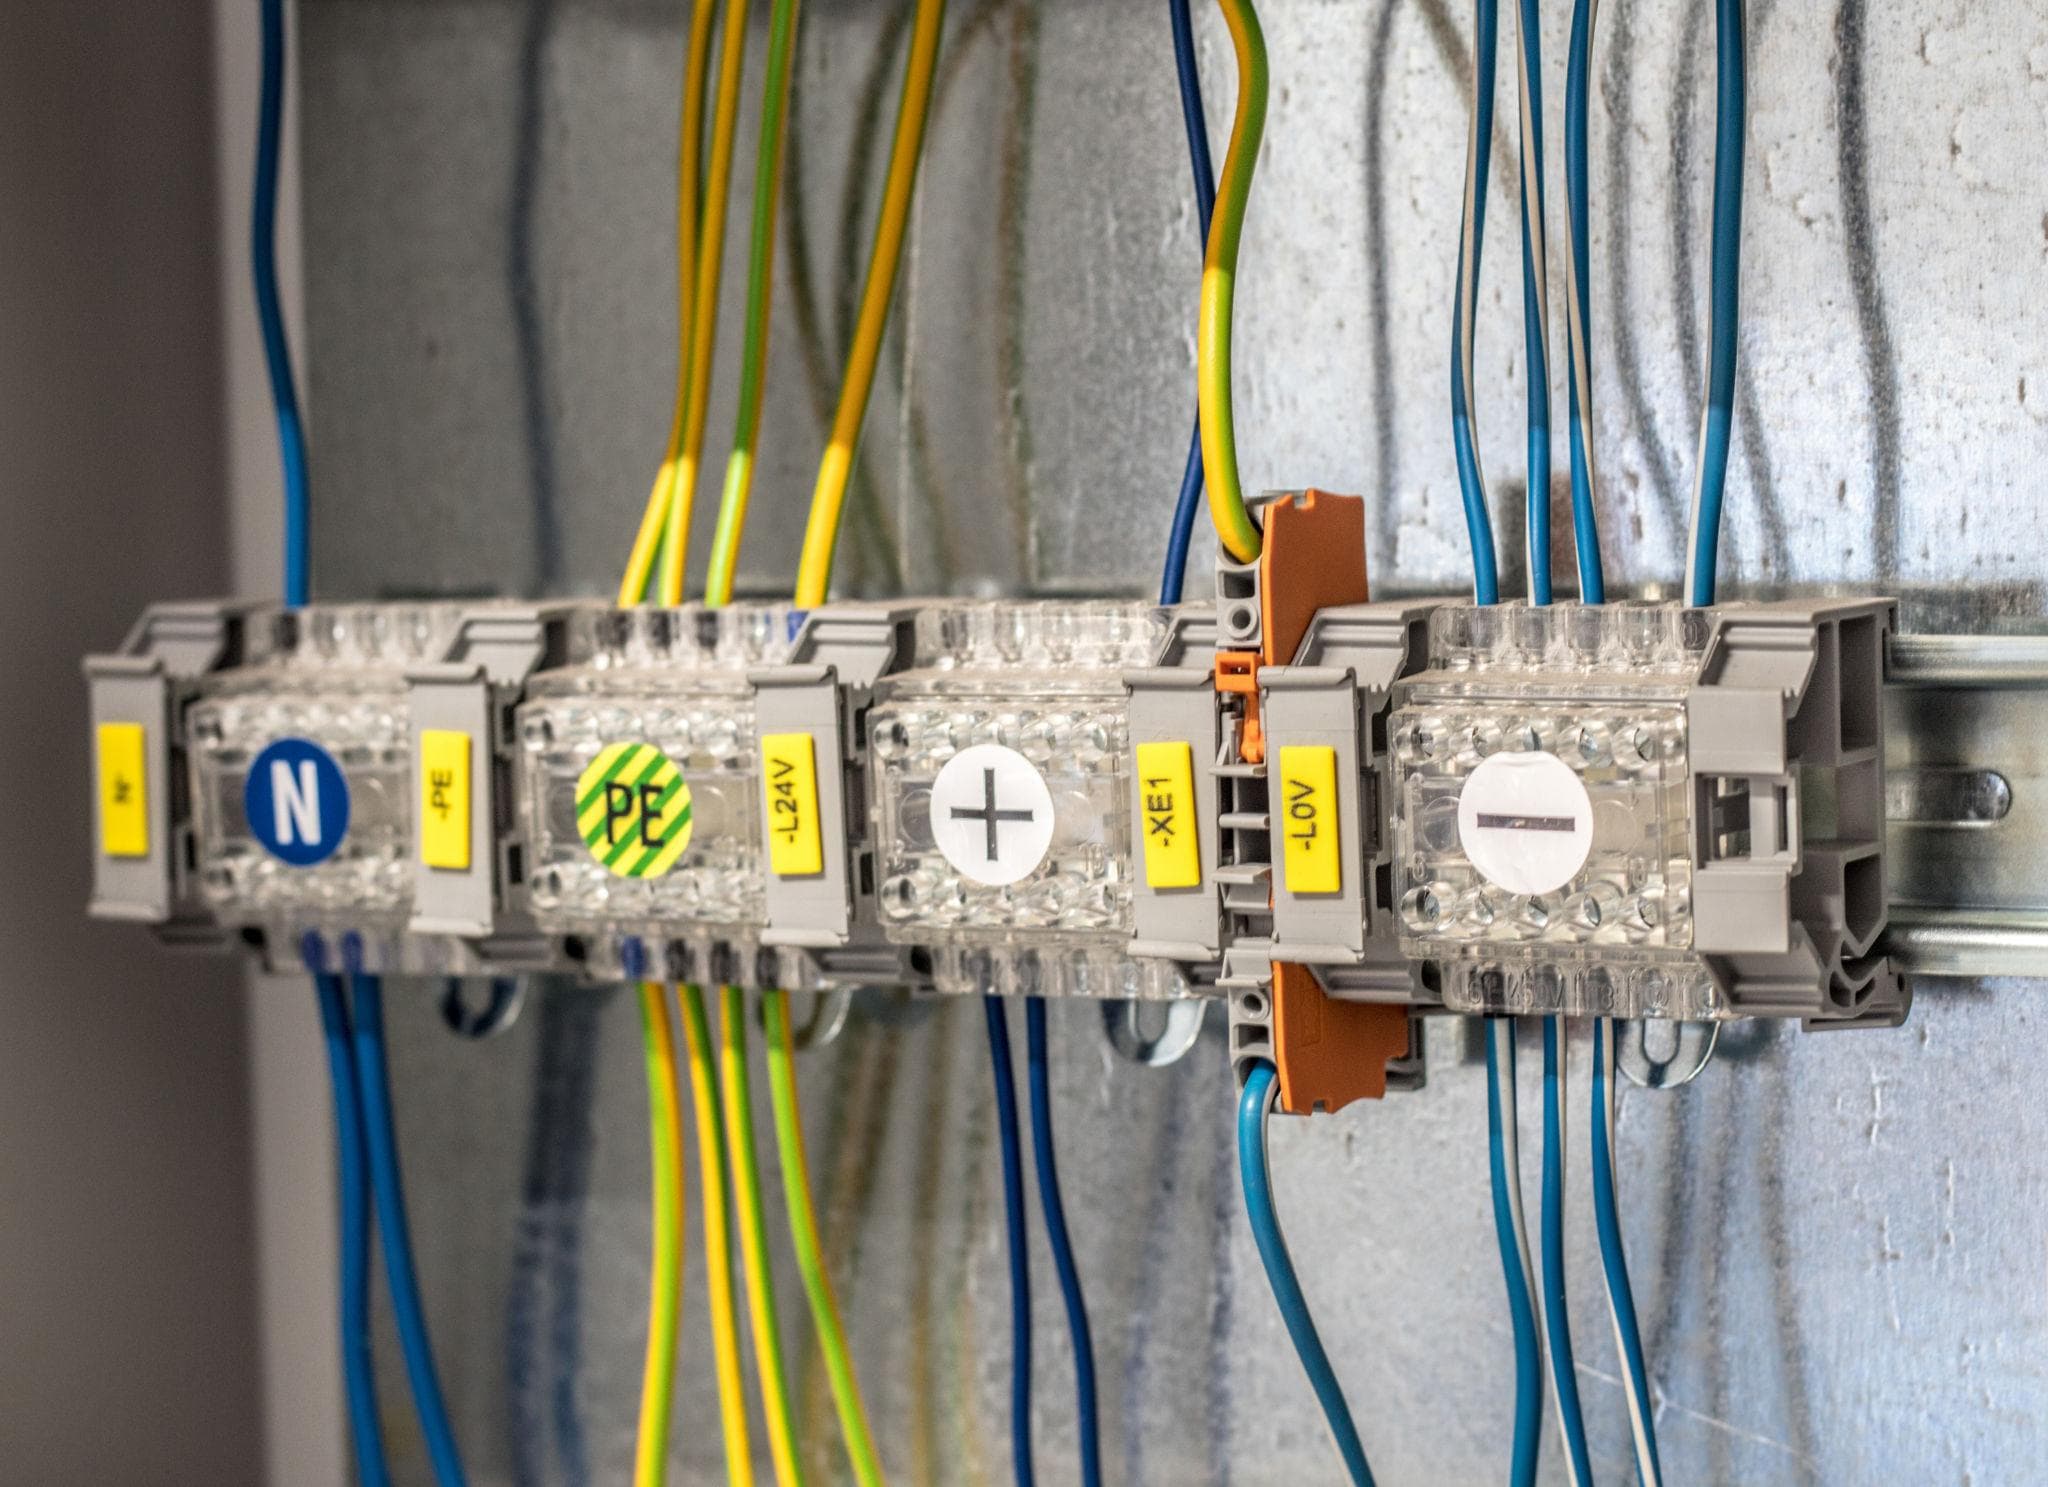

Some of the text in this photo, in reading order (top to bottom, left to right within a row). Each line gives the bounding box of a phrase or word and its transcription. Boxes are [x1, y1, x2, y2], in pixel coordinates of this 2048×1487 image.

[272, 759, 321, 846] N
[430, 769, 453, 821] -PE
[604, 781, 665, 848] PE
[771, 758, 799, 844] -L24V
[1147, 777, 1175, 847] -XE1
